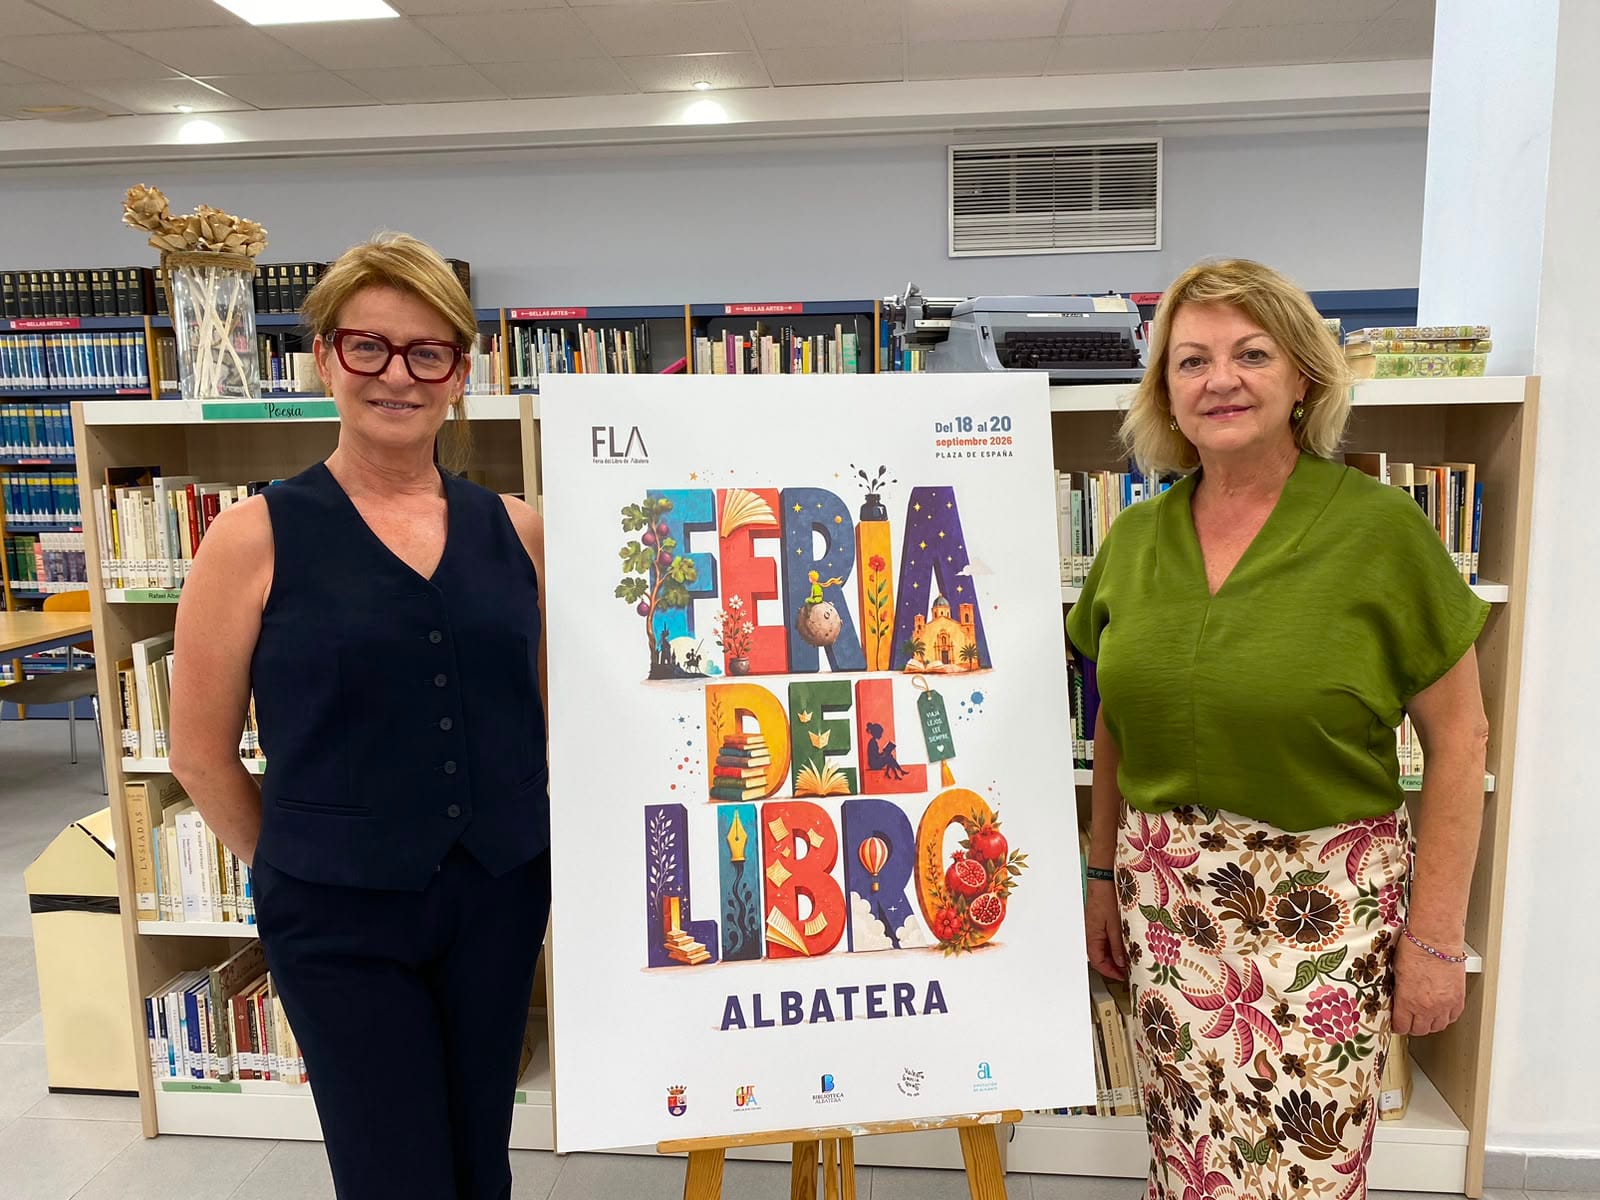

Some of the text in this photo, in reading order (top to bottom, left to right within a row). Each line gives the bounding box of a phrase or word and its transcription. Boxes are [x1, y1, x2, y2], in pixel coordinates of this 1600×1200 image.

[592, 426, 648, 457] FLA
[935, 416, 1011, 433] Del 18 al 20
[936, 436, 1013, 448] septiembre 2026
[981, 449, 1013, 458] ESPAÑA
[646, 486, 993, 677] FERIA
[705, 679, 928, 802] DEL
[644, 788, 1011, 969] LIBRO
[720, 980, 949, 1032] ALBATERA
